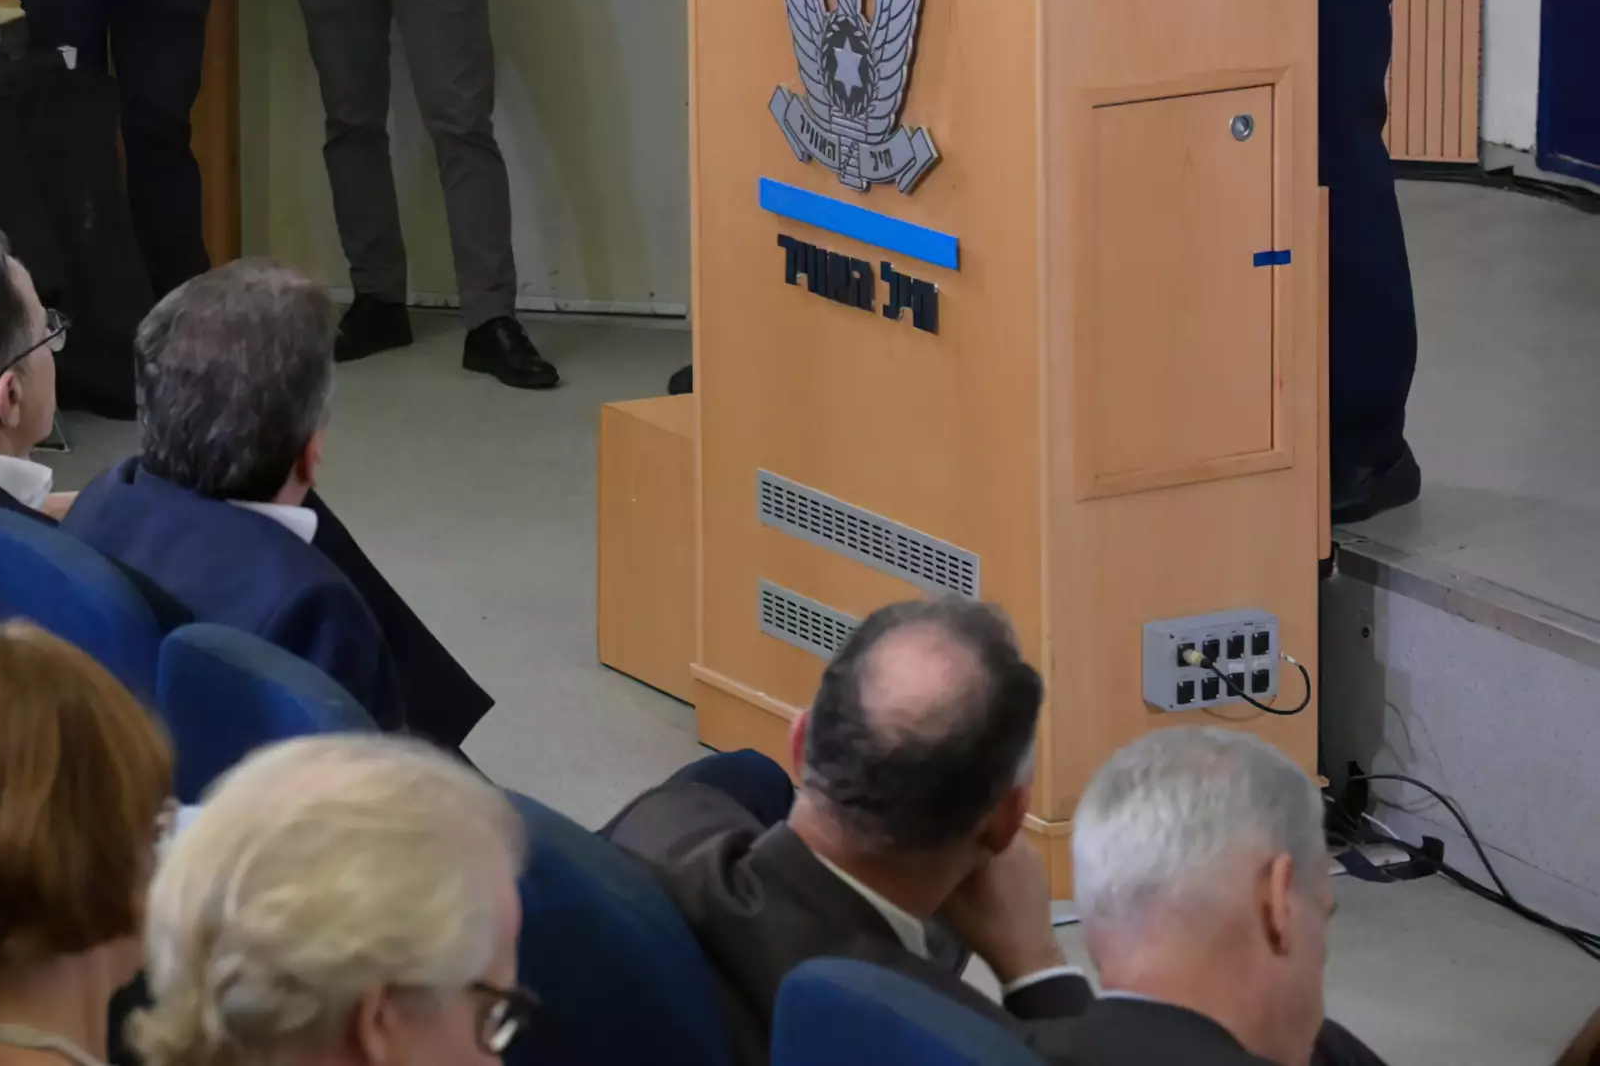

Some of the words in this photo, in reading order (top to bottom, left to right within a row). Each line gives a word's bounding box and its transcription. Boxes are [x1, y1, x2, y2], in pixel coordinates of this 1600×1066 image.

[800, 114, 836, 161] האוויר
[870, 148, 893, 172] חיל
[777, 234, 875, 313] האוויר
[880, 261, 939, 335] חיל
